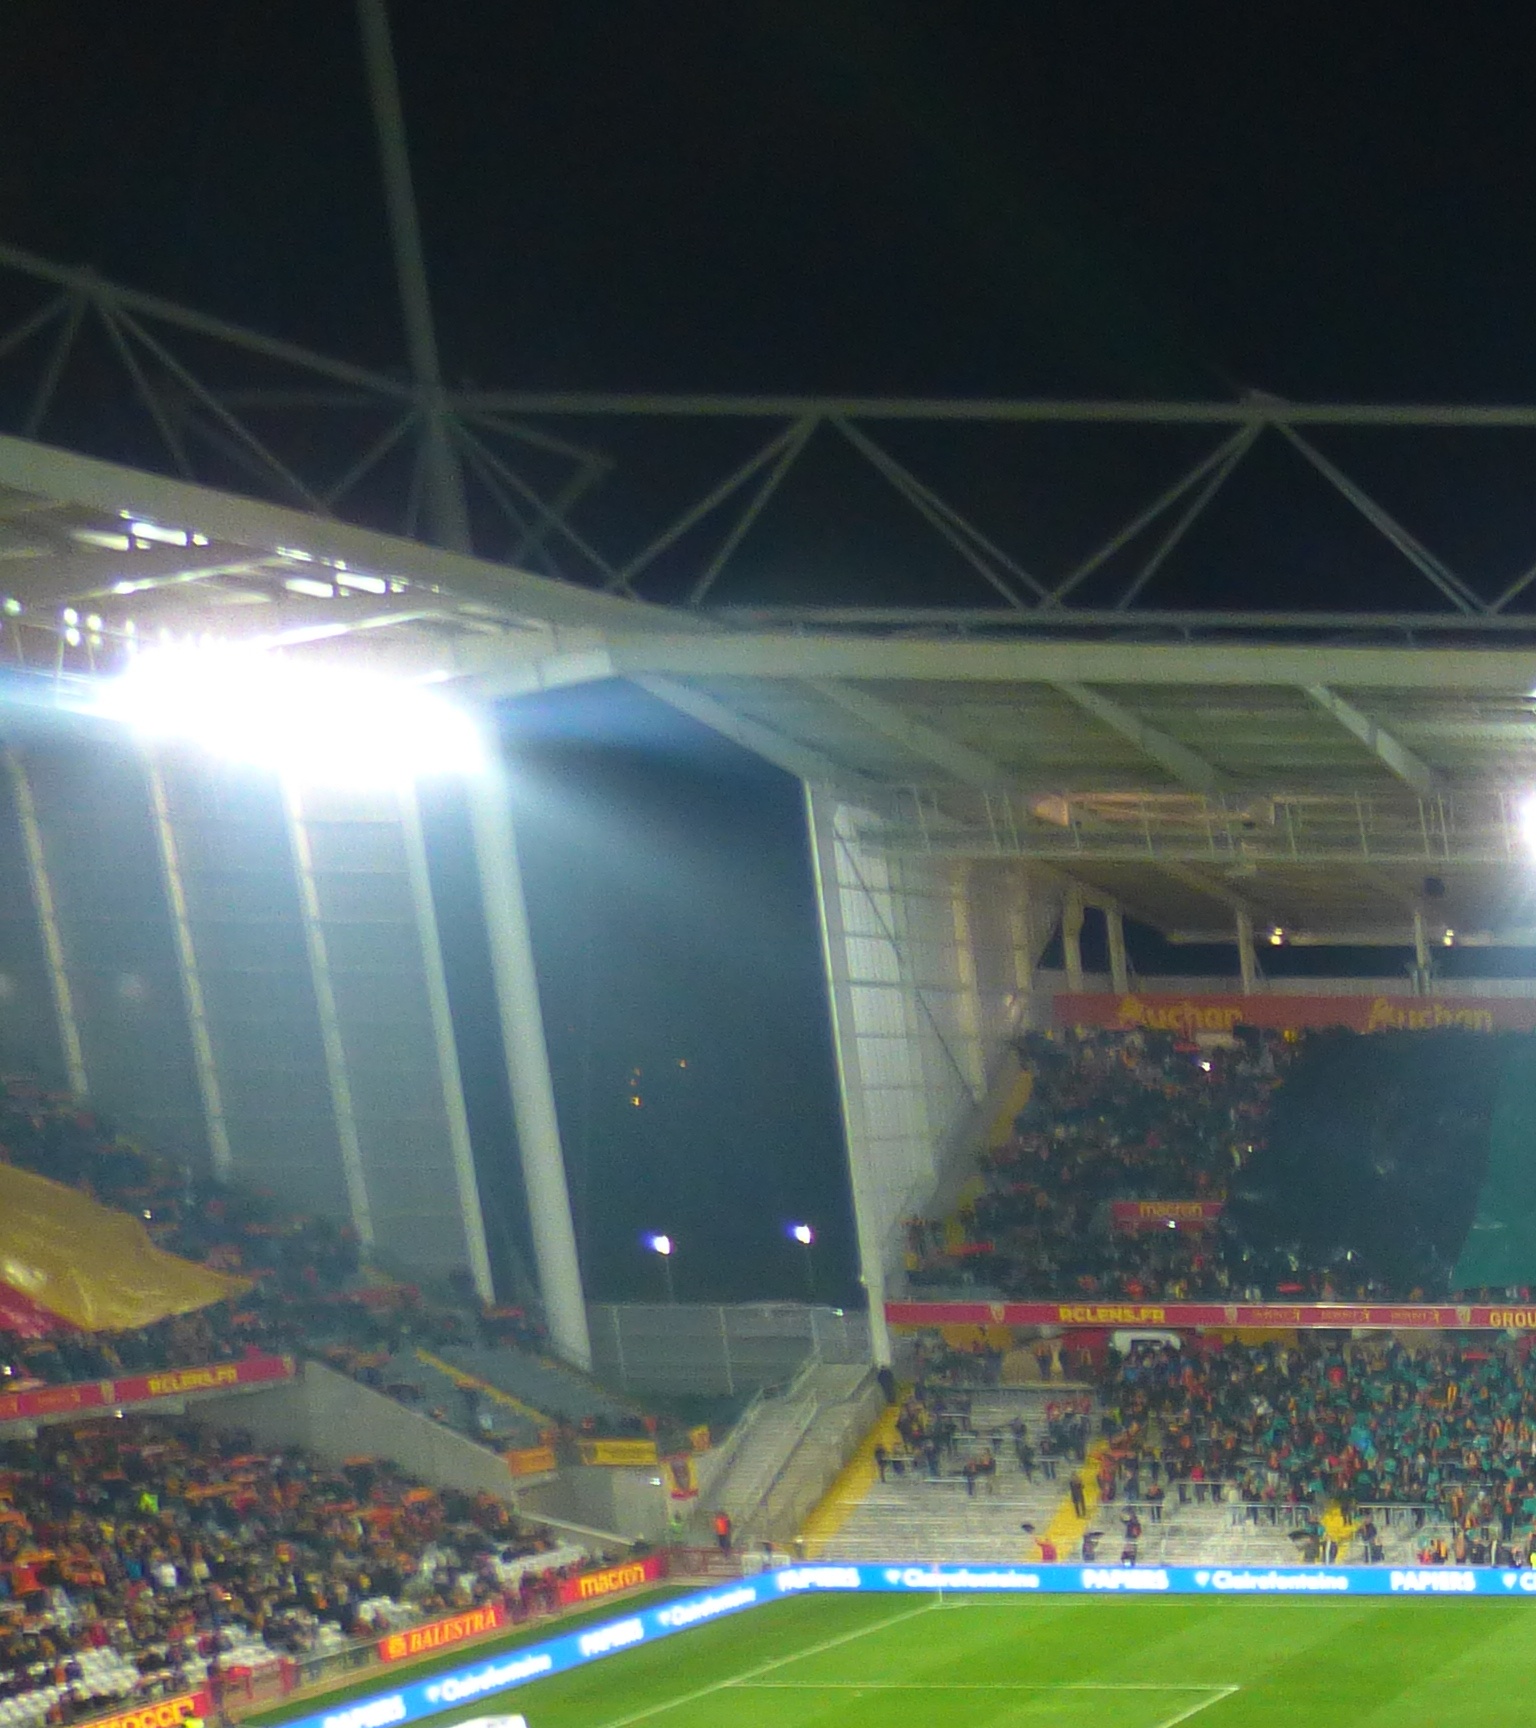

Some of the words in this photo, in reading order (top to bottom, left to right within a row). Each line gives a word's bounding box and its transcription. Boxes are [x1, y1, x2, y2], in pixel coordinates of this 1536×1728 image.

[1058, 1307, 1165, 1323] RCLENS.FR
[580, 1566, 645, 1599] macron
[410, 1607, 498, 1654] BALESTRA
